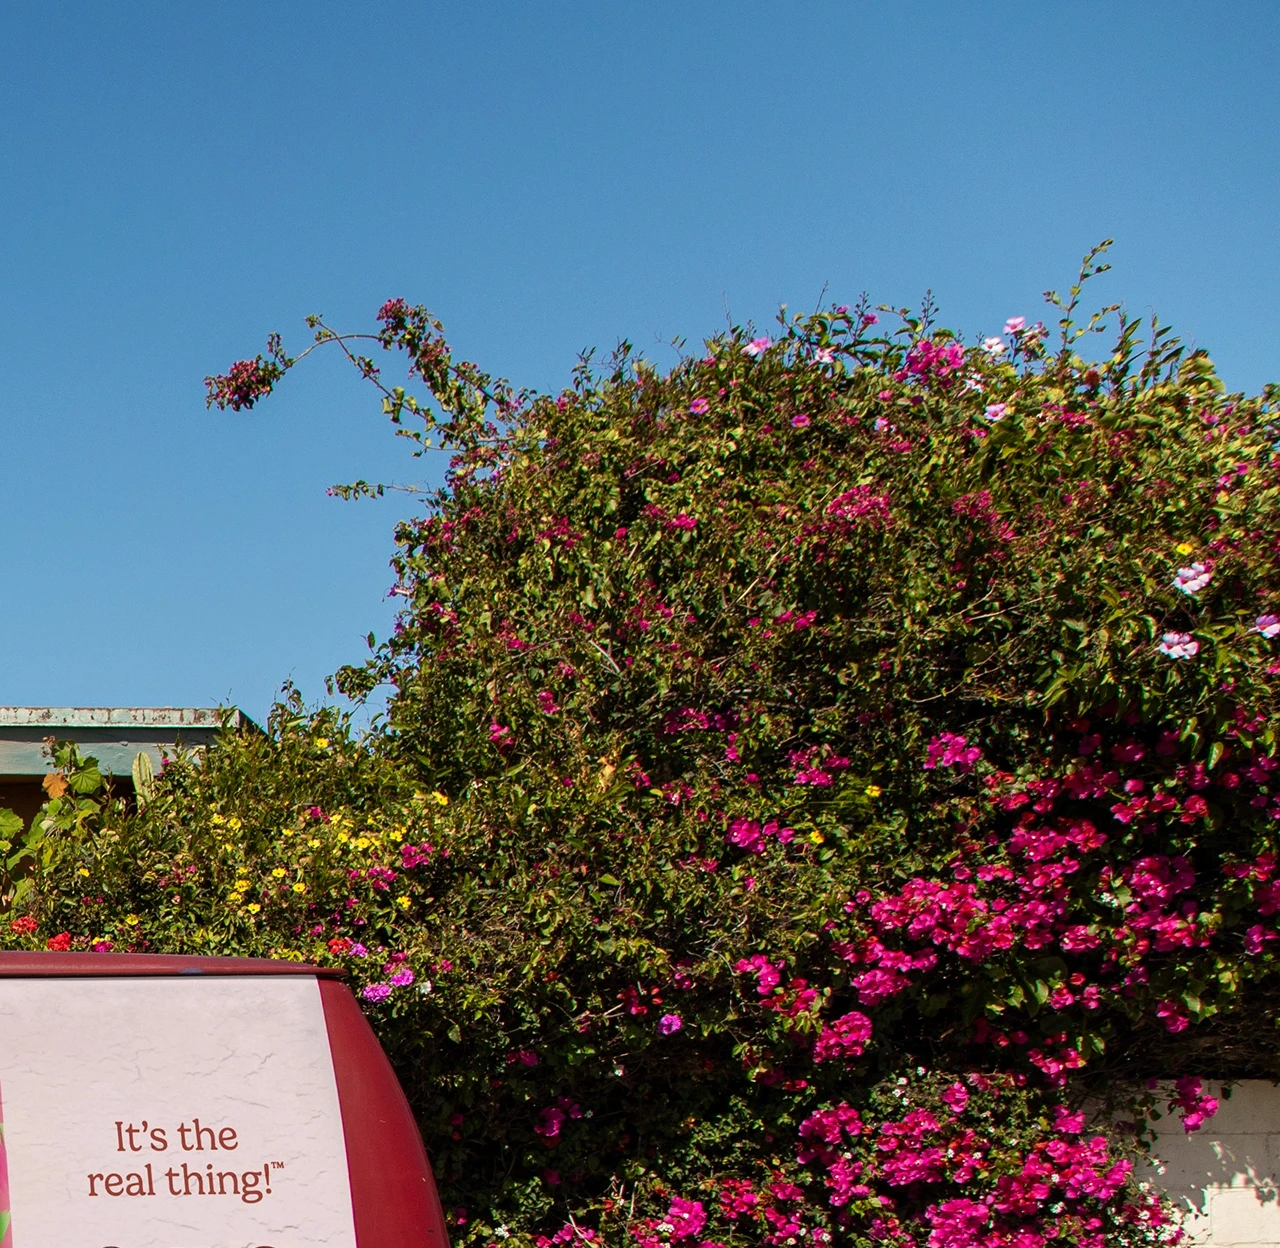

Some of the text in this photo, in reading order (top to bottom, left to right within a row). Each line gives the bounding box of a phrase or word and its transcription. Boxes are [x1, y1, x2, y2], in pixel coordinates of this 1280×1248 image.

[114, 1118, 239, 1152] It's the
[87, 1163, 156, 1197] real
